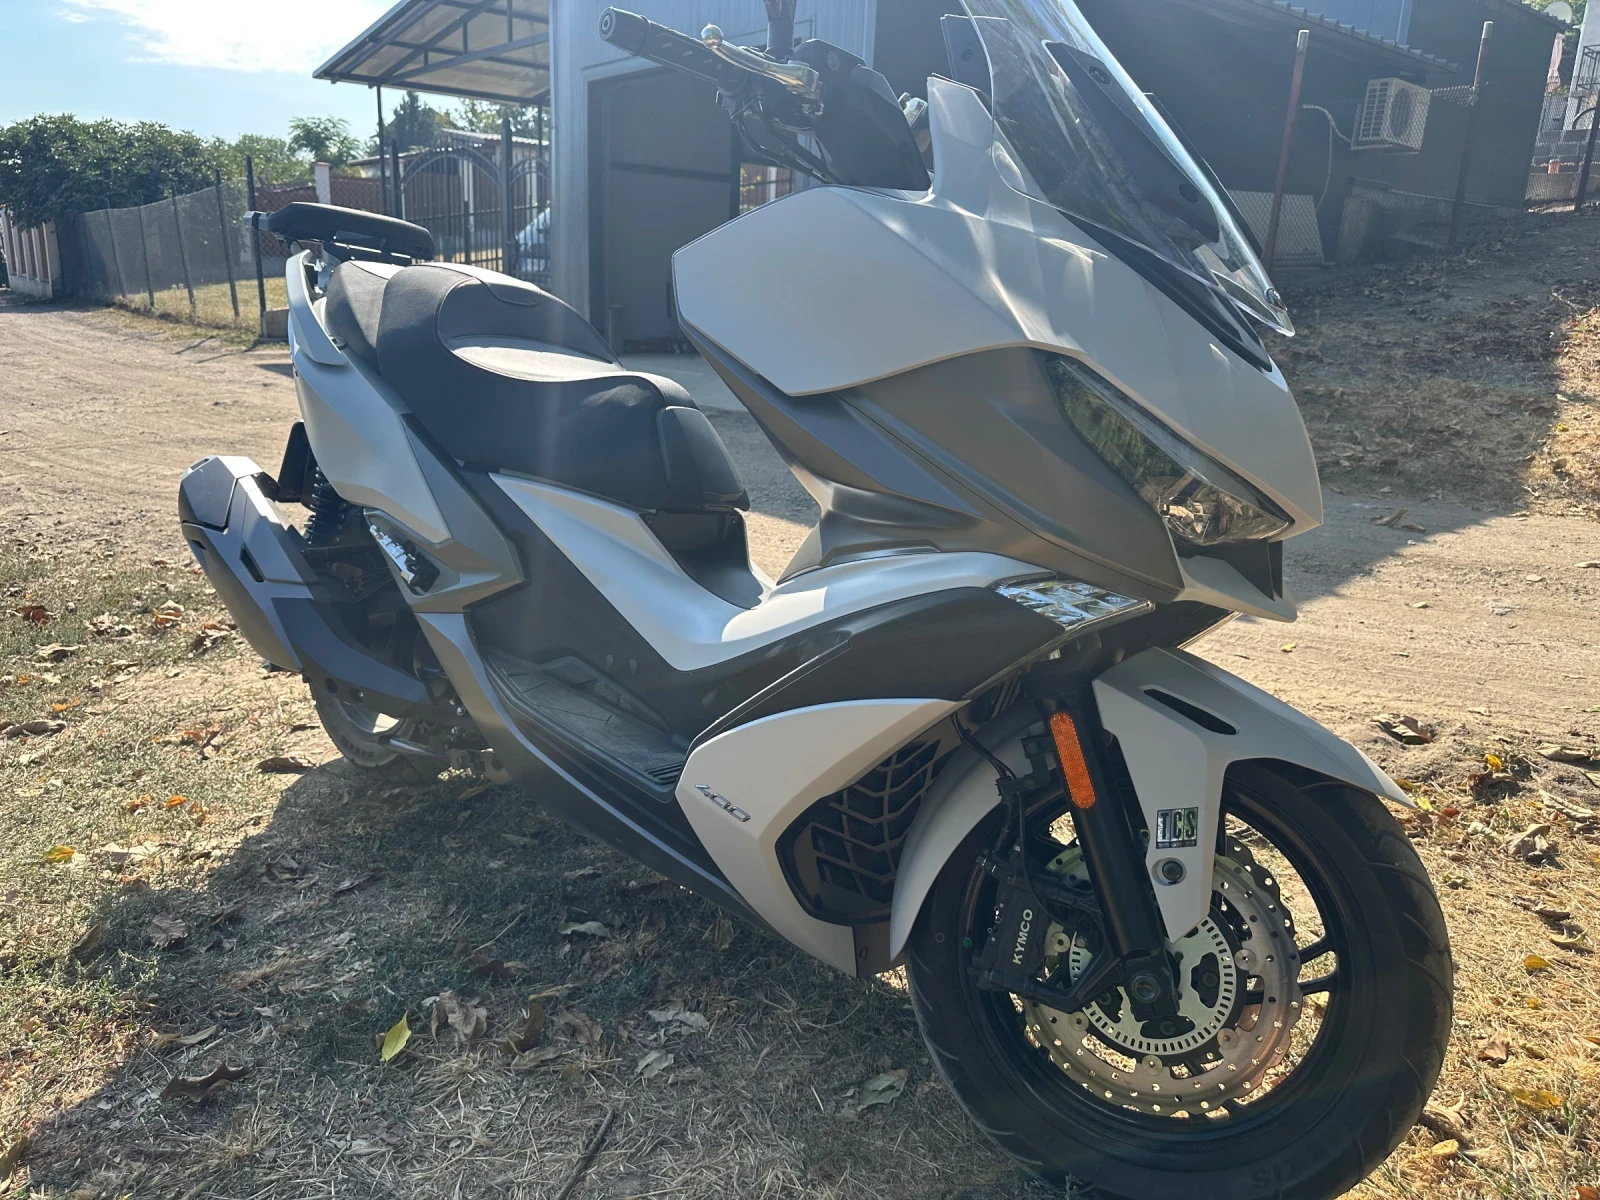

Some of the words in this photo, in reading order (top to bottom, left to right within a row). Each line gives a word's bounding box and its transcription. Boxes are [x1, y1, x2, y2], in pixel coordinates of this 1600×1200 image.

[694, 783, 751, 823] 400
[1160, 810, 1196, 840] TCS
[1012, 908, 1033, 965] KYMCO
